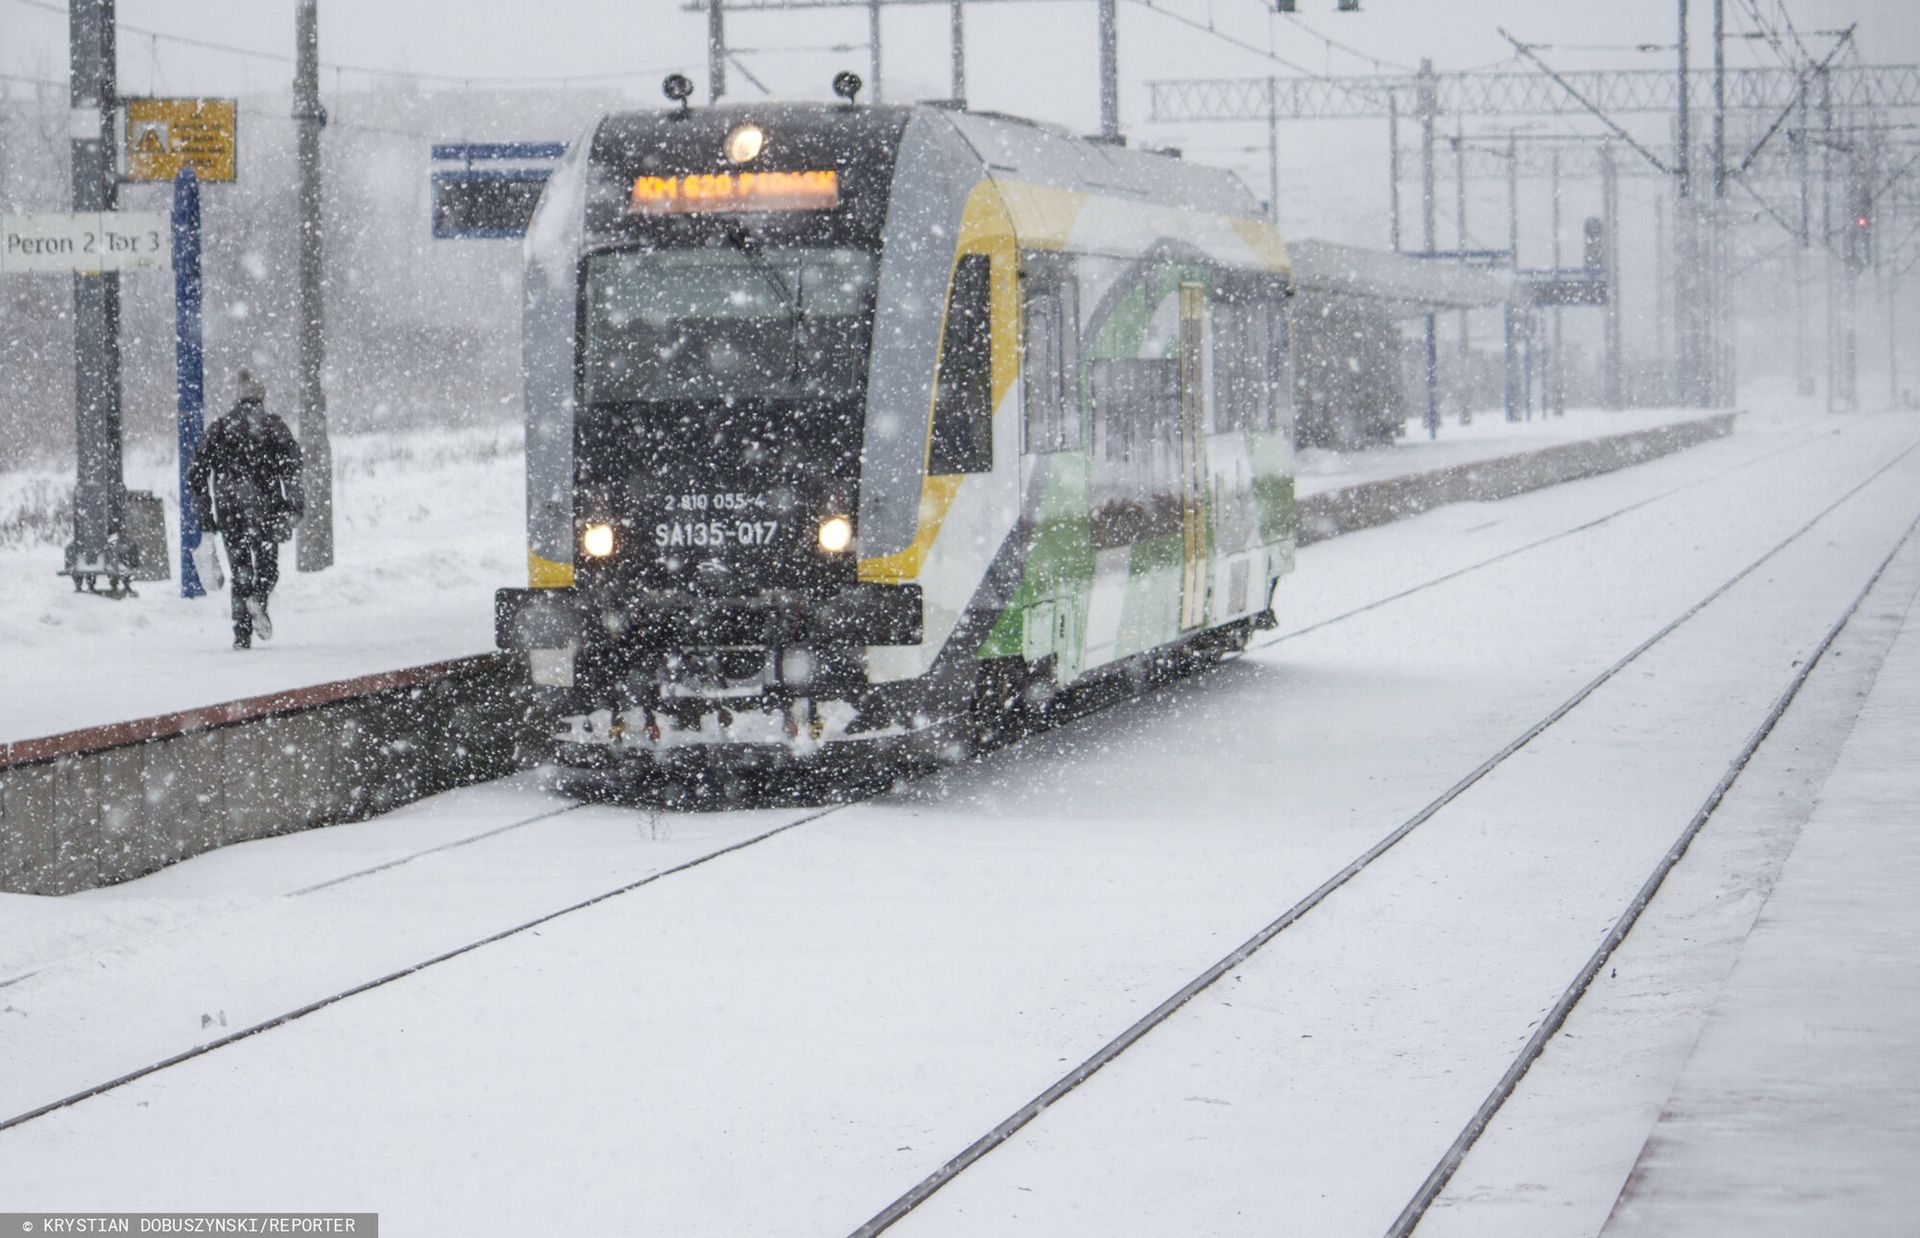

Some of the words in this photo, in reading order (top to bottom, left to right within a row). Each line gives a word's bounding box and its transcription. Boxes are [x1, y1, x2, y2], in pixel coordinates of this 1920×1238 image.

[8, 232, 73, 254] Peron
[82, 231, 95, 253] 2
[105, 231, 141, 252] Tor
[148, 230, 160, 252] 3
[664, 495, 676, 511] 2
[655, 520, 778, 547] SA135-017
